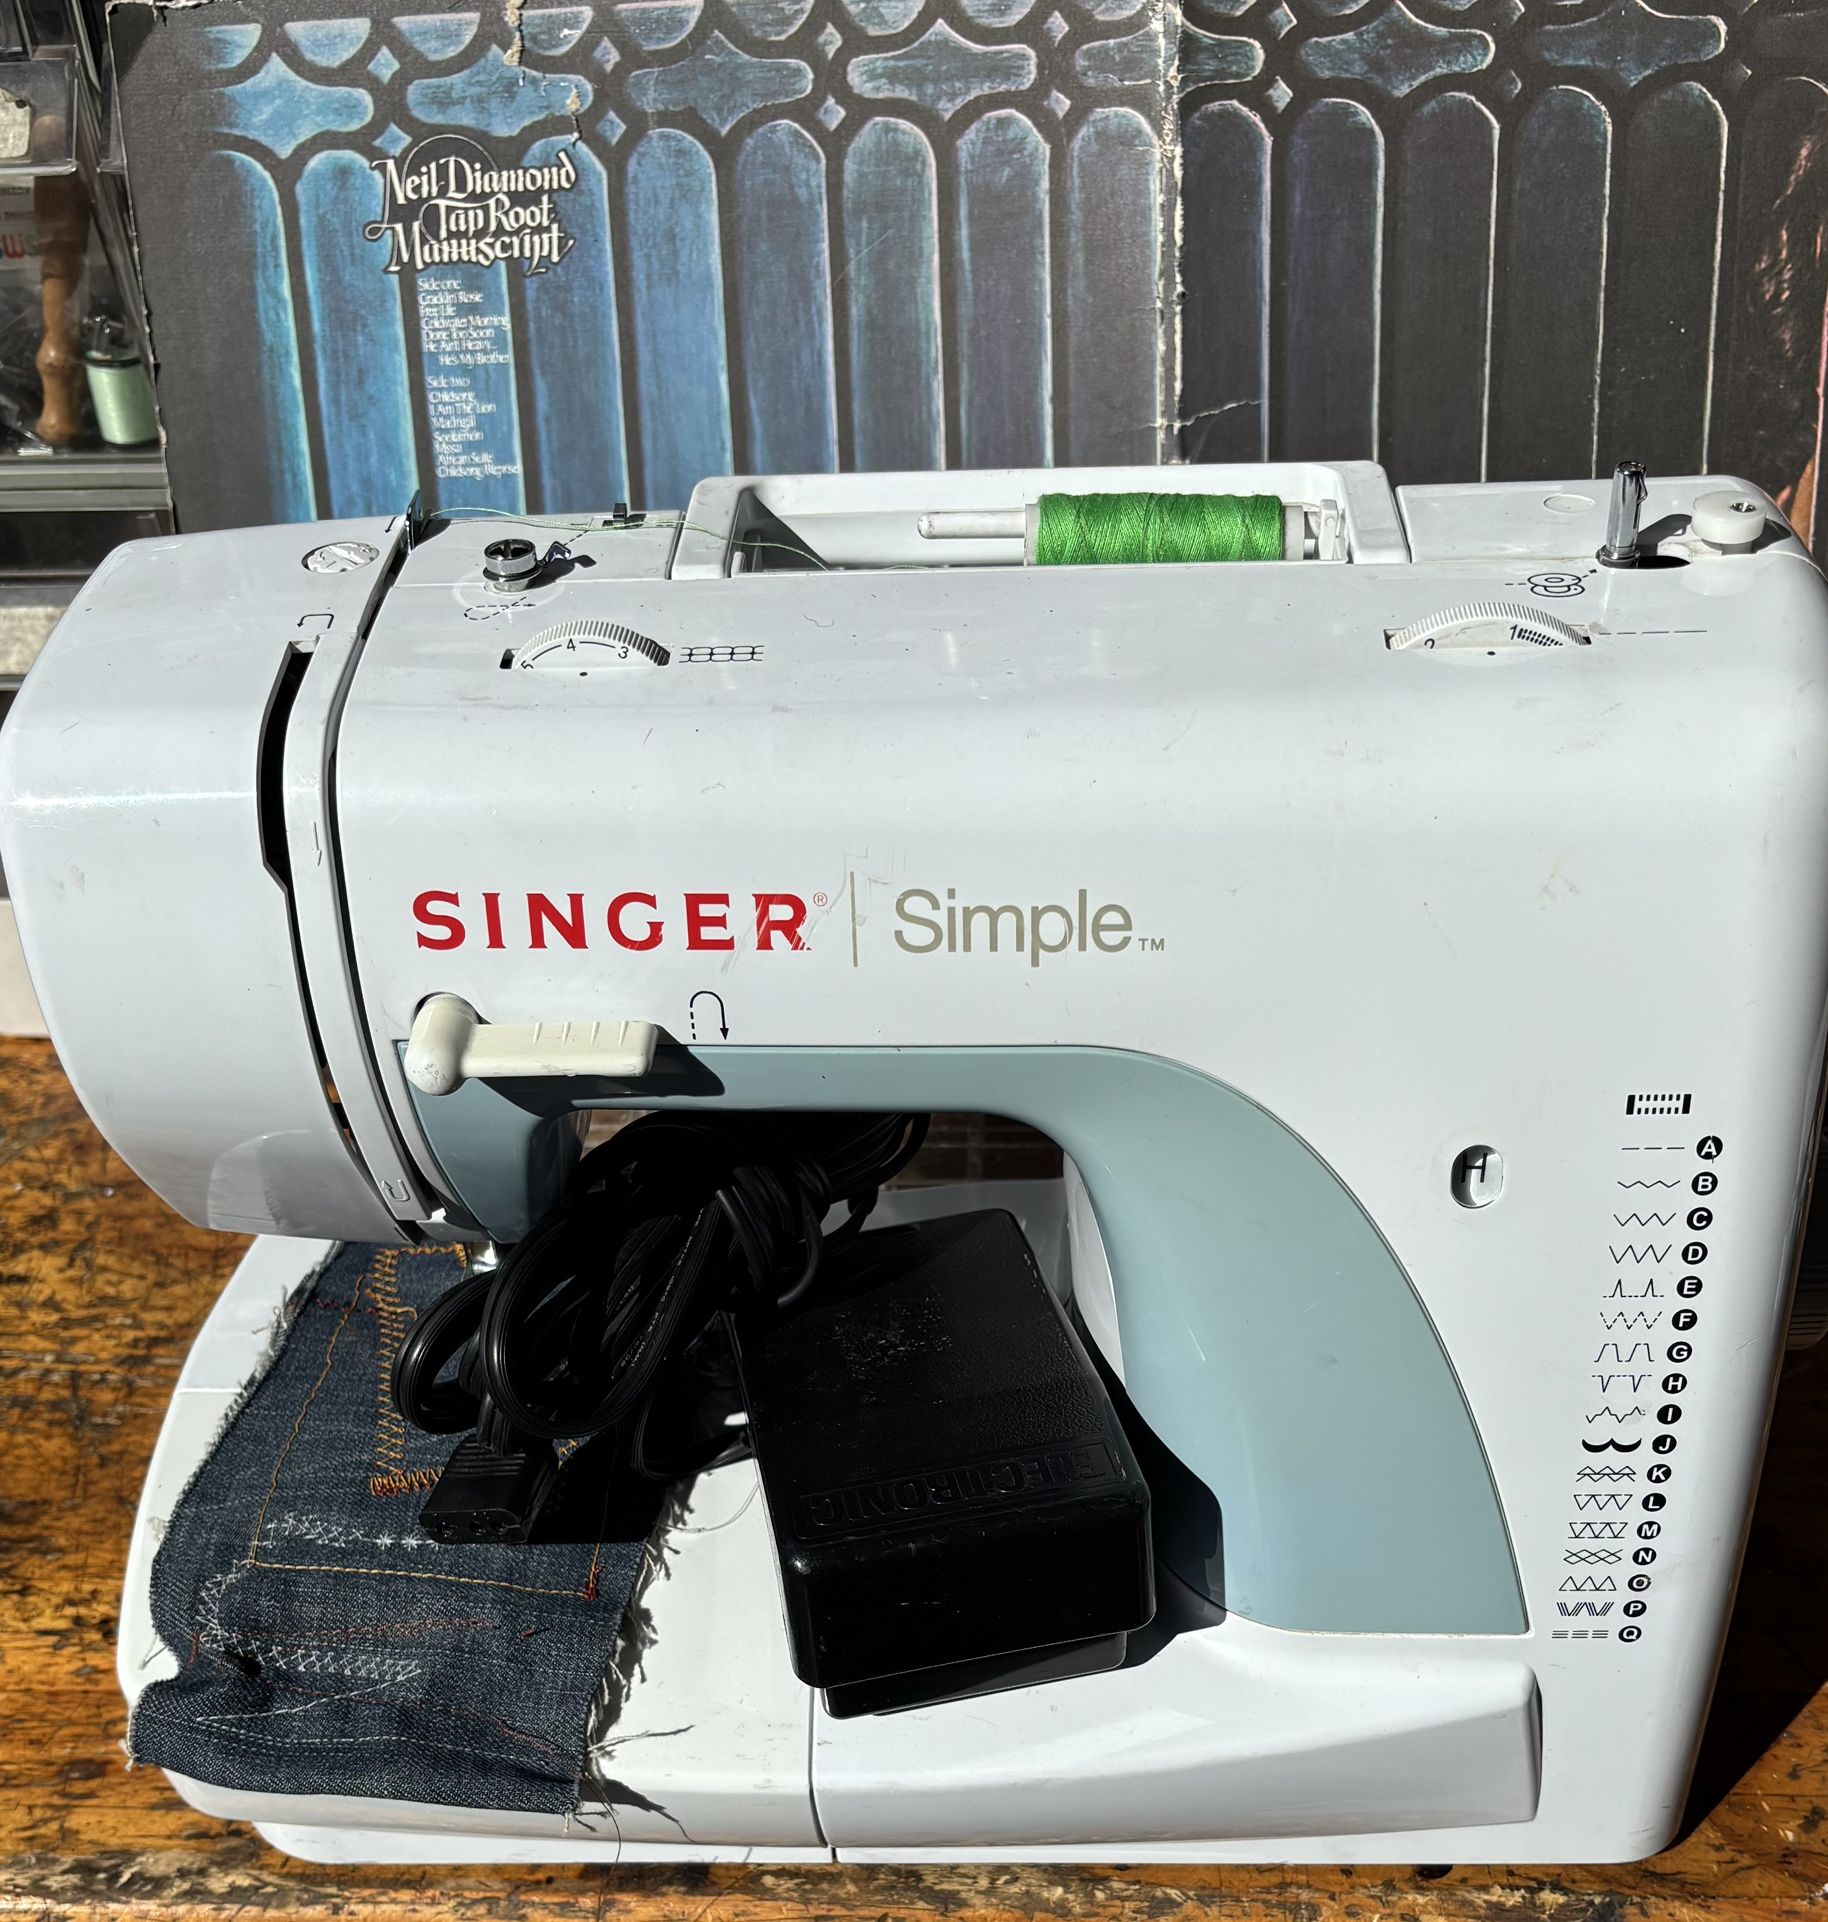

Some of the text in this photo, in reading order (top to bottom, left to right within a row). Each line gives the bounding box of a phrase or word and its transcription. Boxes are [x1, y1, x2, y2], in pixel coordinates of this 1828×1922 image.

[371, 149, 576, 205] Neil Diamond
[421, 193, 555, 240] Tap Root
[386, 222, 574, 275] Manuscript
[566, 638, 577, 652] 4
[617, 646, 630, 659] 3
[893, 888, 1134, 968] Simple
[1699, 1138, 1719, 1158] A
[1461, 1151, 1488, 1183] H
[1696, 1174, 1715, 1193] B
[1691, 1209, 1710, 1228] C
[1686, 1244, 1705, 1263] D
[1681, 1278, 1700, 1296] E
[1677, 1311, 1695, 1329] F
[1670, 1343, 1689, 1361] G
[1666, 1375, 1684, 1392] H
[1657, 1436, 1673, 1453] J
[1650, 1465, 1669, 1483] K
[809, 1448, 1093, 1526] ELECTRONIC
[1646, 1494, 1662, 1510] L
[1640, 1522, 1659, 1538] M
[1637, 1549, 1655, 1564] N
[1631, 1575, 1650, 1590] O
[1627, 1601, 1644, 1616] P
[1621, 1626, 1639, 1642] Q
